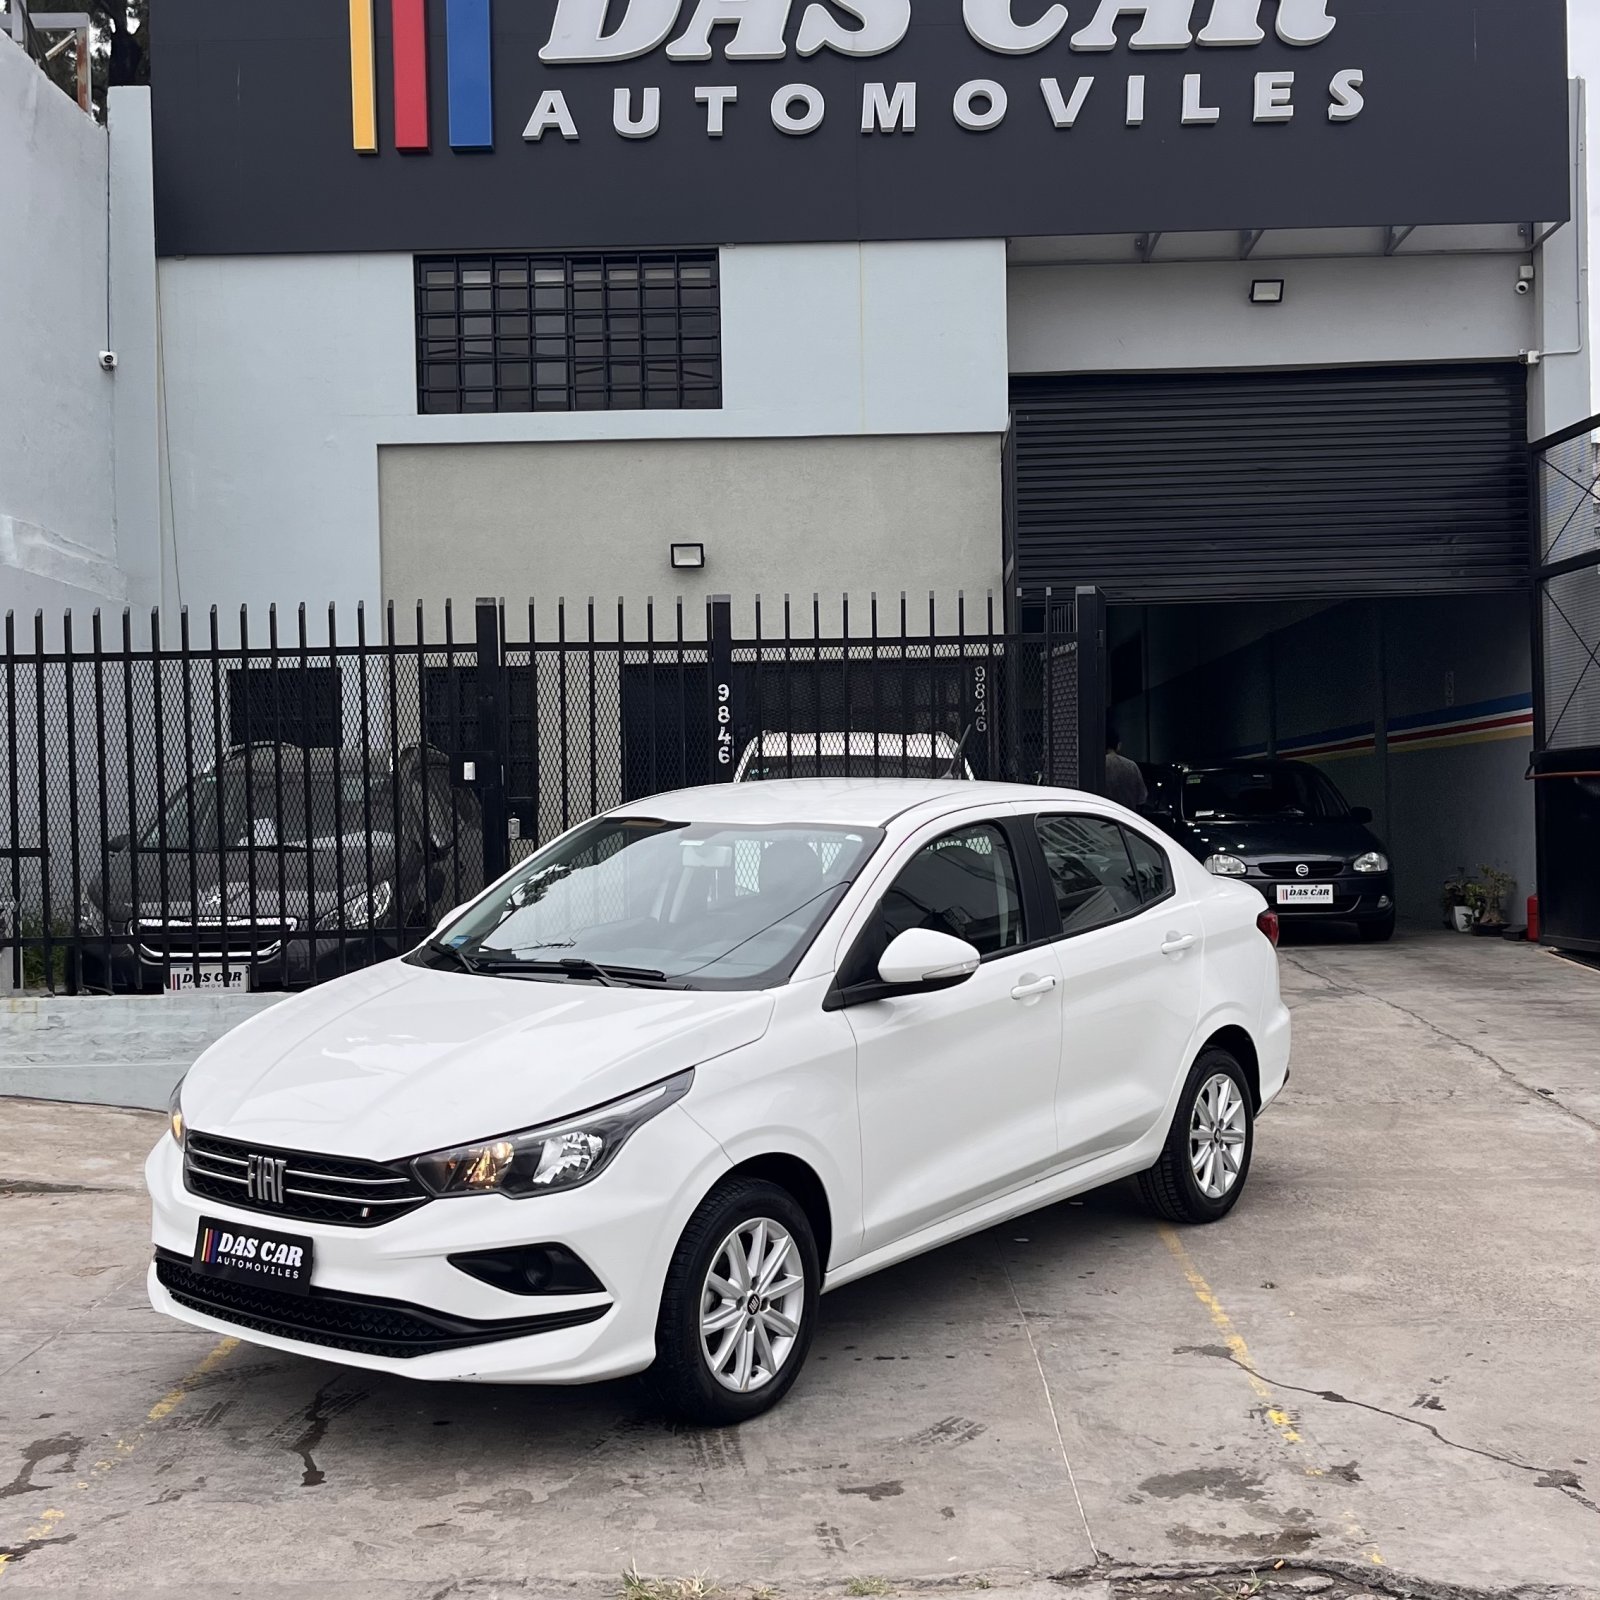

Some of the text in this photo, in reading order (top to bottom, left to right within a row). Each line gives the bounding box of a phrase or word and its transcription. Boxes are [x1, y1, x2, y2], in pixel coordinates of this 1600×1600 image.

[522, 68, 1364, 140] AUTOMOVILES
[717, 683, 731, 764] 9846
[974, 665, 987, 732] 9846
[182, 973, 211, 983] DS
[247, 1153, 288, 1204] FIAT
[216, 1255, 300, 1280] AUTOMOVILES
[217, 1232, 304, 1268] DAS CAR
